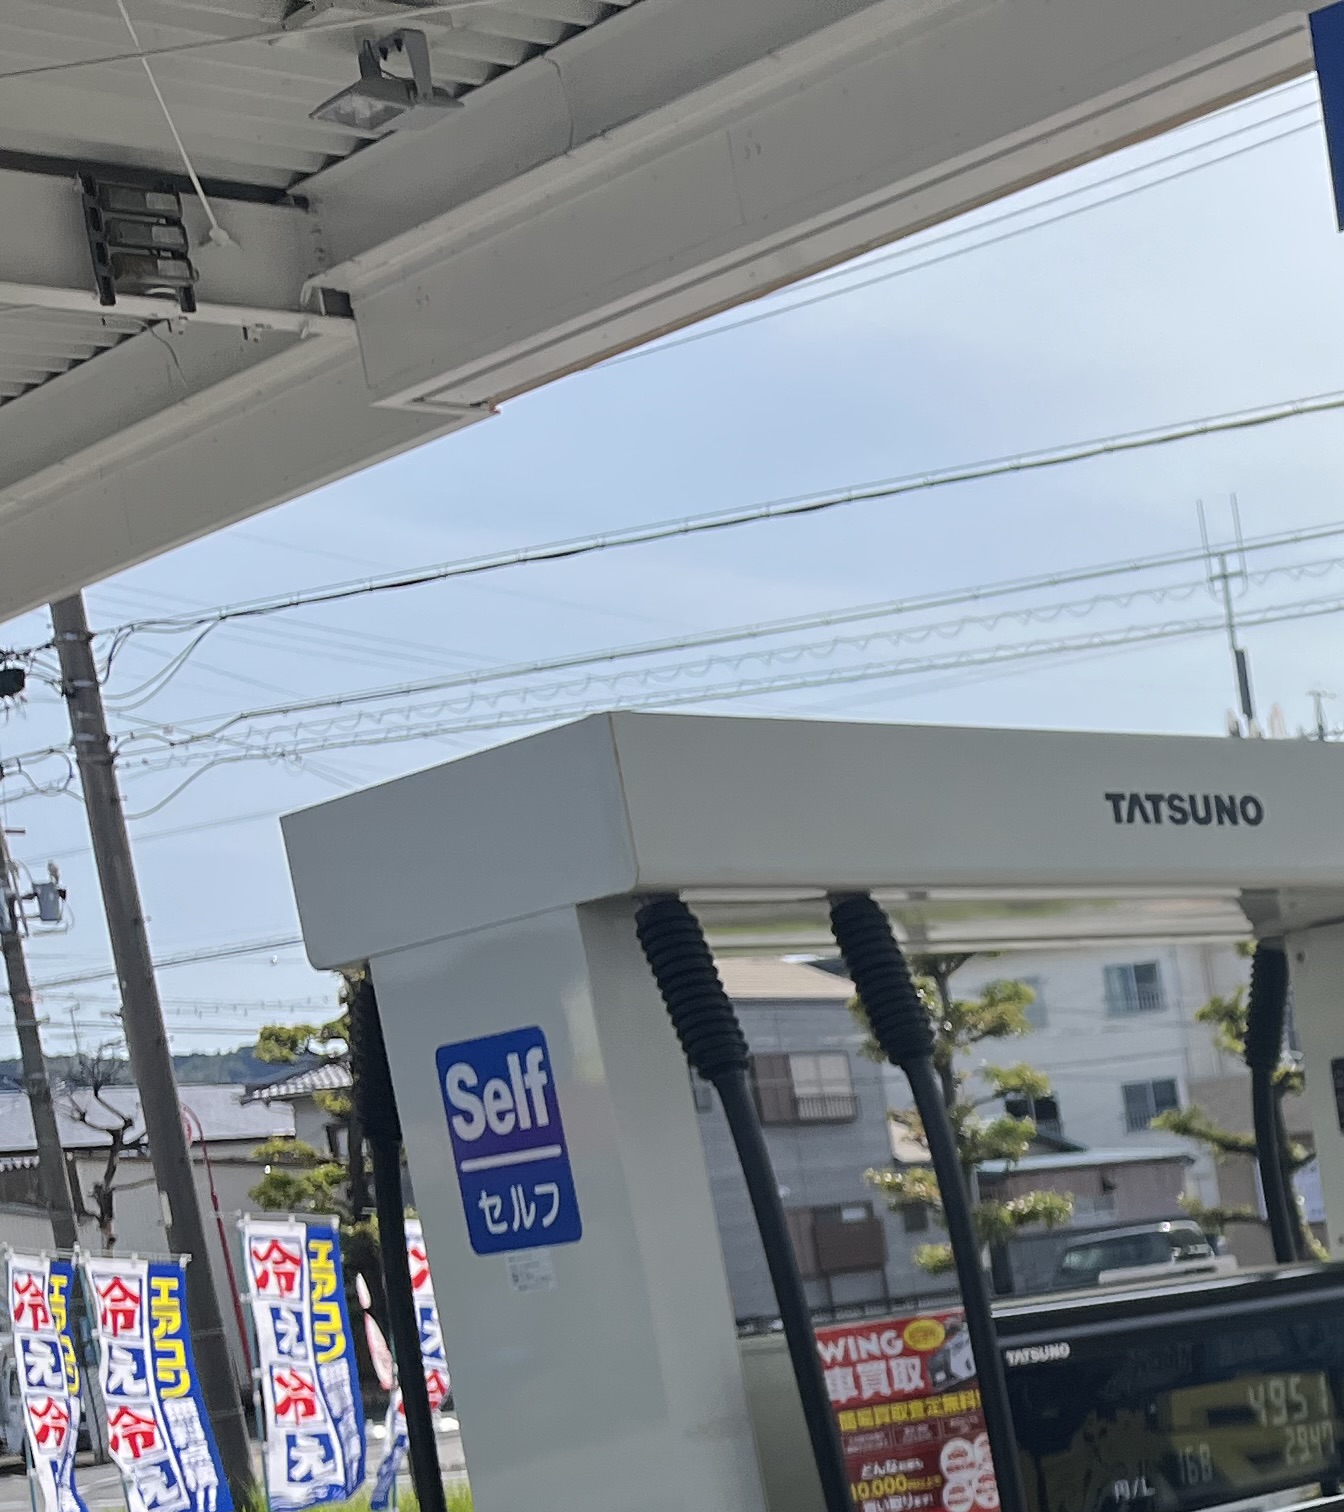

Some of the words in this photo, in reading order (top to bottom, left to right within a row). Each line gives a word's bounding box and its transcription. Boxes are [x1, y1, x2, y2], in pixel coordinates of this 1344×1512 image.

[1104, 793, 1265, 826] TATSUNO
[446, 1046, 549, 1141] Self
[478, 1181, 561, 1235] セルフ
[149, 1277, 191, 1398] エアコン
[308, 1239, 348, 1363] エアコン
[1006, 1341, 1070, 1367] TATSUNO
[97, 1276, 179, 1507] 冷え冷え
[252, 1238, 335, 1483] 冷え冷え
